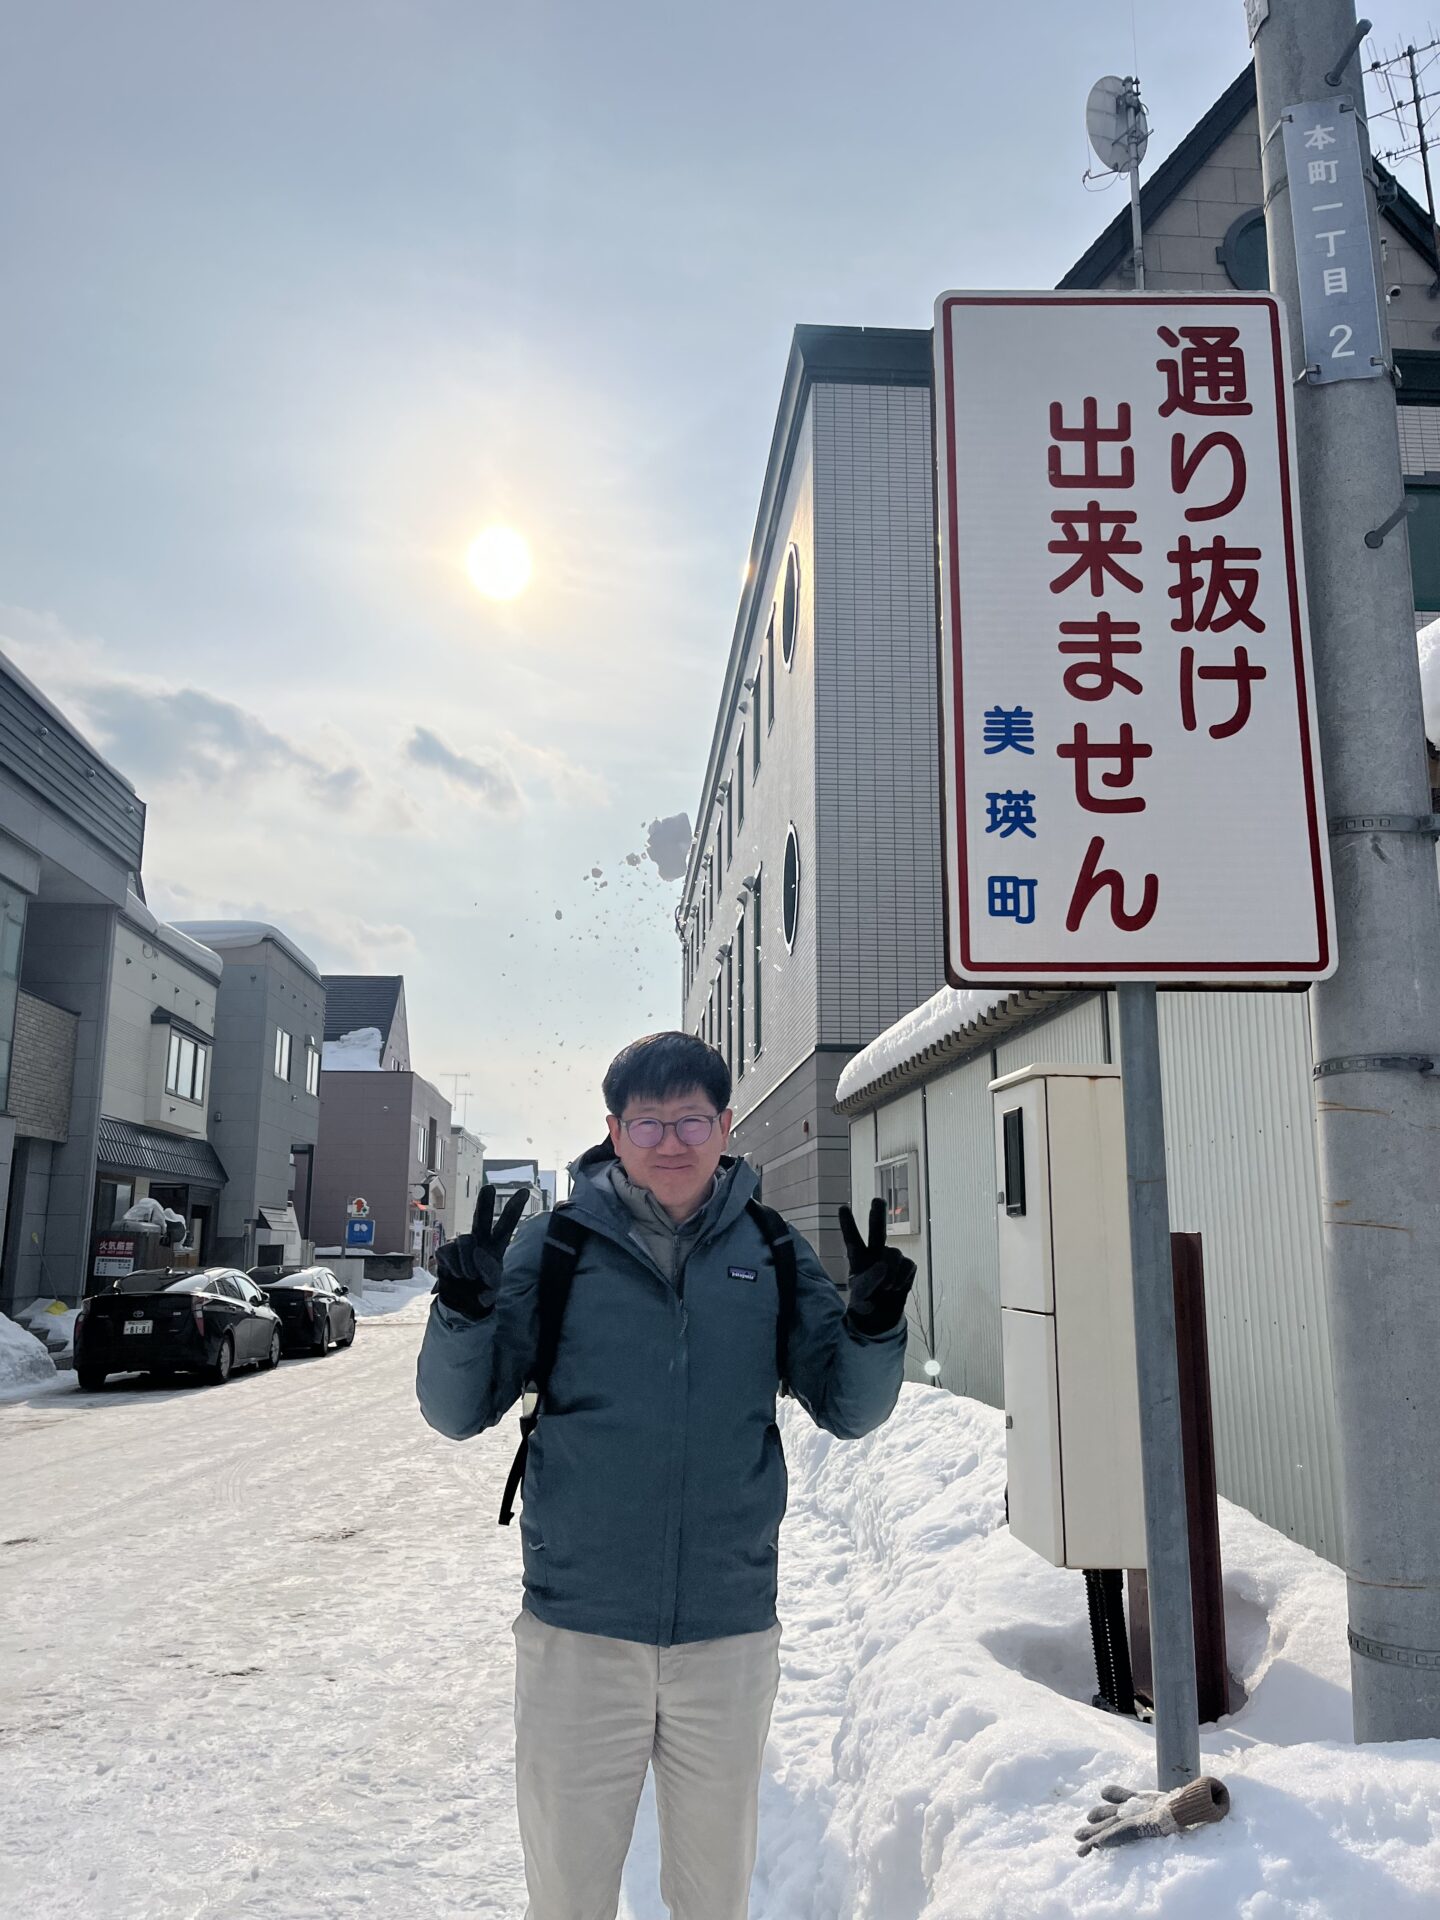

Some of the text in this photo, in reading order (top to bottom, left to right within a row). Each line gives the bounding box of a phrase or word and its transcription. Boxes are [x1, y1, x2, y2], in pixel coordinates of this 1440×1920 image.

[1303, 124, 1355, 359] 本町一丁目 2
[1048, 396, 1159, 932] 出来ません
[1156, 325, 1266, 740] 通り抜け
[984, 706, 1038, 924] 美瑛町
